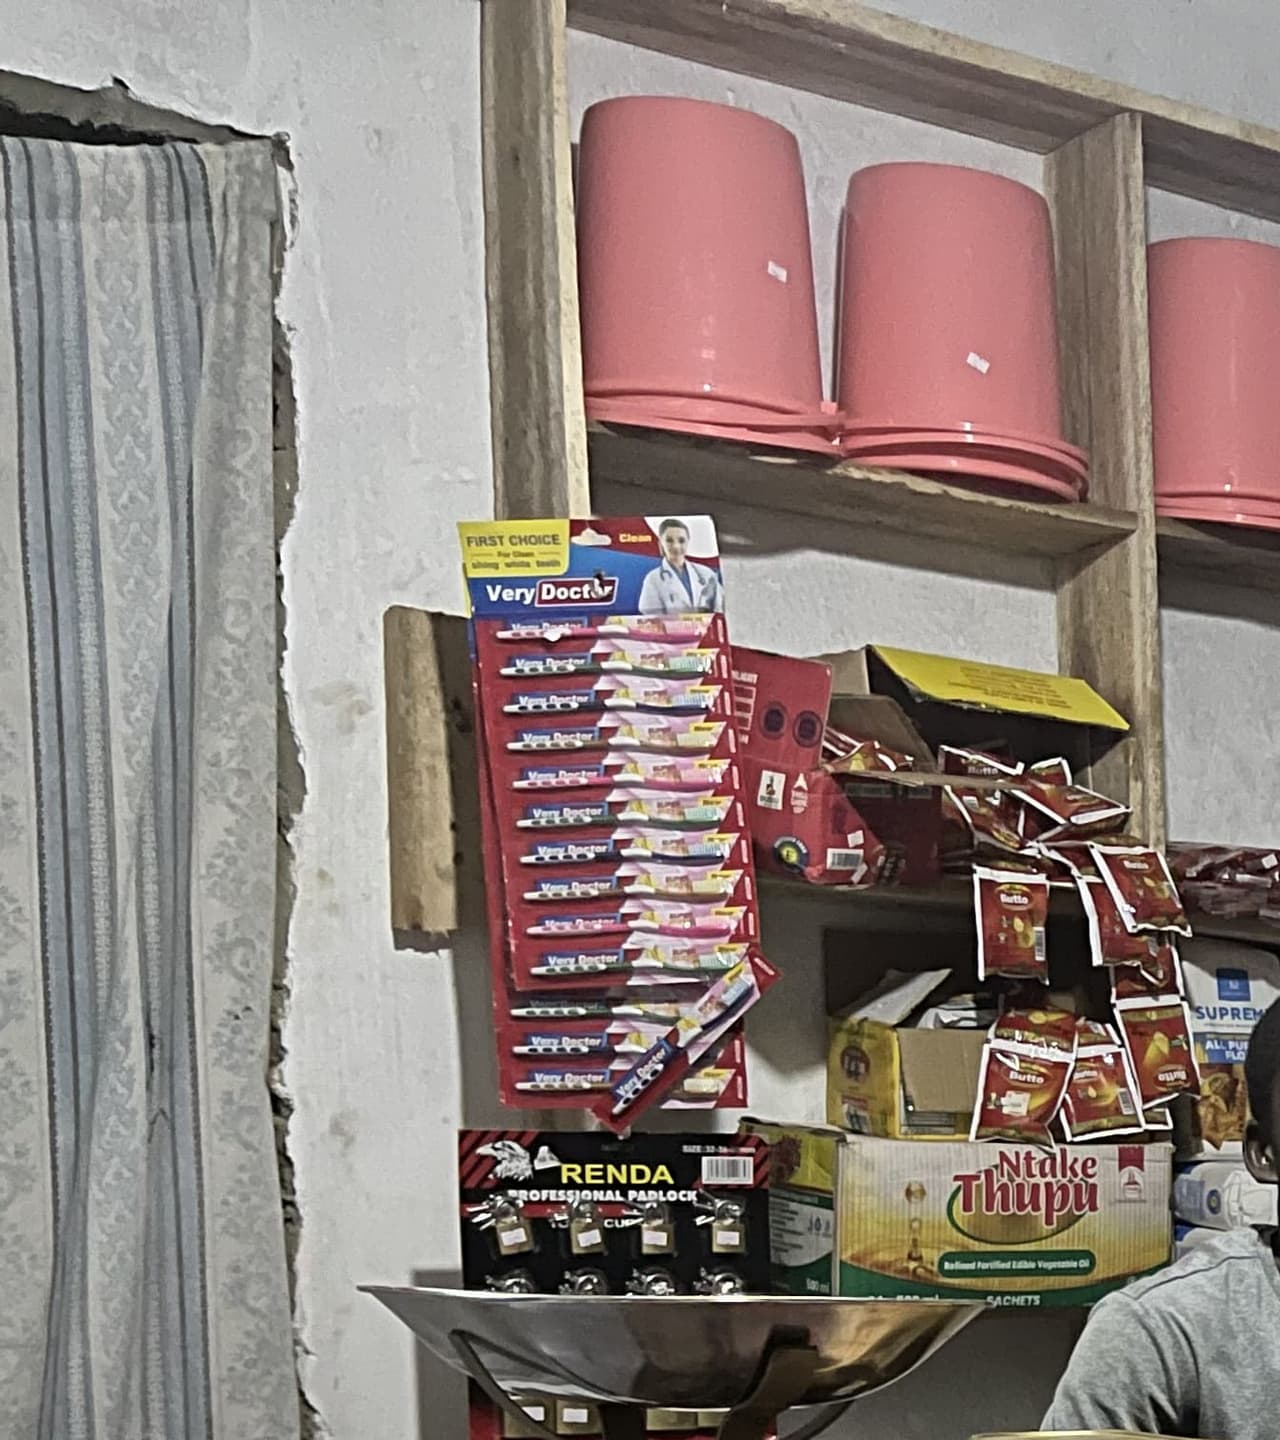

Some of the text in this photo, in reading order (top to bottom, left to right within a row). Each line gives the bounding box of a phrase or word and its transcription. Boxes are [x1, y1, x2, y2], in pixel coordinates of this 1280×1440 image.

[467, 534, 561, 548] FIRST CHOICE
[619, 533, 652, 544] Clean
[504, 559, 531, 569] white
[486, 584, 536, 605] Very
[533, 806, 603, 819] Very Doctor
[537, 843, 608, 856] Very Doctor
[999, 892, 1030, 906] Butto
[548, 952, 619, 967] Very Doctor
[532, 1035, 601, 1047] Very Doctor
[1205, 1040, 1224, 1050] ALL
[534, 1070, 605, 1083] Very Doctor
[615, 1046, 667, 1098] Very Doctor
[1009, 1070, 1045, 1086] Butto
[1158, 1071, 1186, 1084] Butto
[998, 1148, 1098, 1182] Ntake
[560, 1164, 675, 1186] RENDA
[508, 1189, 698, 1202] PROFESSIONAL PADLOCK
[954, 1170, 1100, 1227] Thupu
[944, 1258, 1090, 1271] Refined Fortified Edible Vegetable Oil
[986, 1295, 1041, 1306] SACHETS
